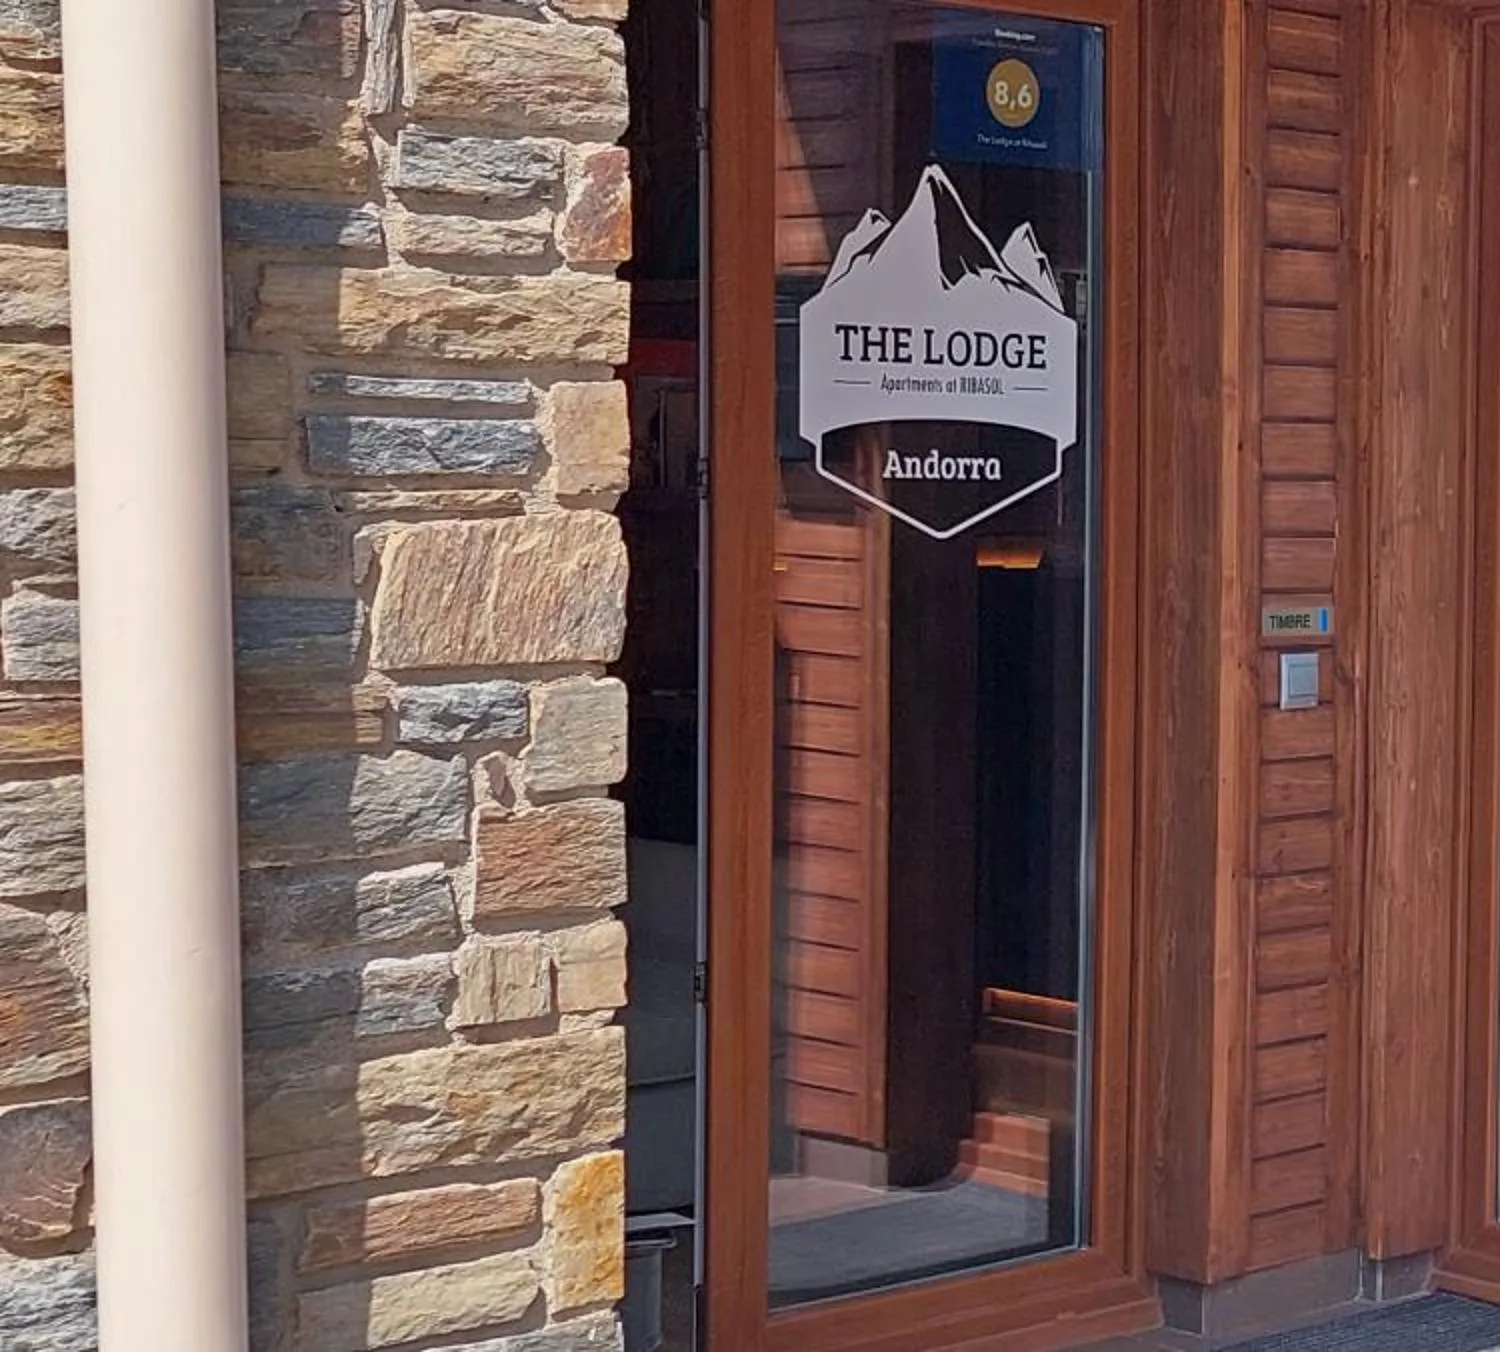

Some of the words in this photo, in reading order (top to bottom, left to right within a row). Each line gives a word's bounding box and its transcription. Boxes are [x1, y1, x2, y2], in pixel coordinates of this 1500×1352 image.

[993, 80, 1033, 111] 8,6
[835, 323, 913, 364] THE
[923, 328, 1047, 370] LODGE
[880, 373, 943, 394] Apartments
[946, 376, 957, 392] at
[959, 376, 1005, 395] RIBASOL
[883, 449, 1002, 480] Andorra
